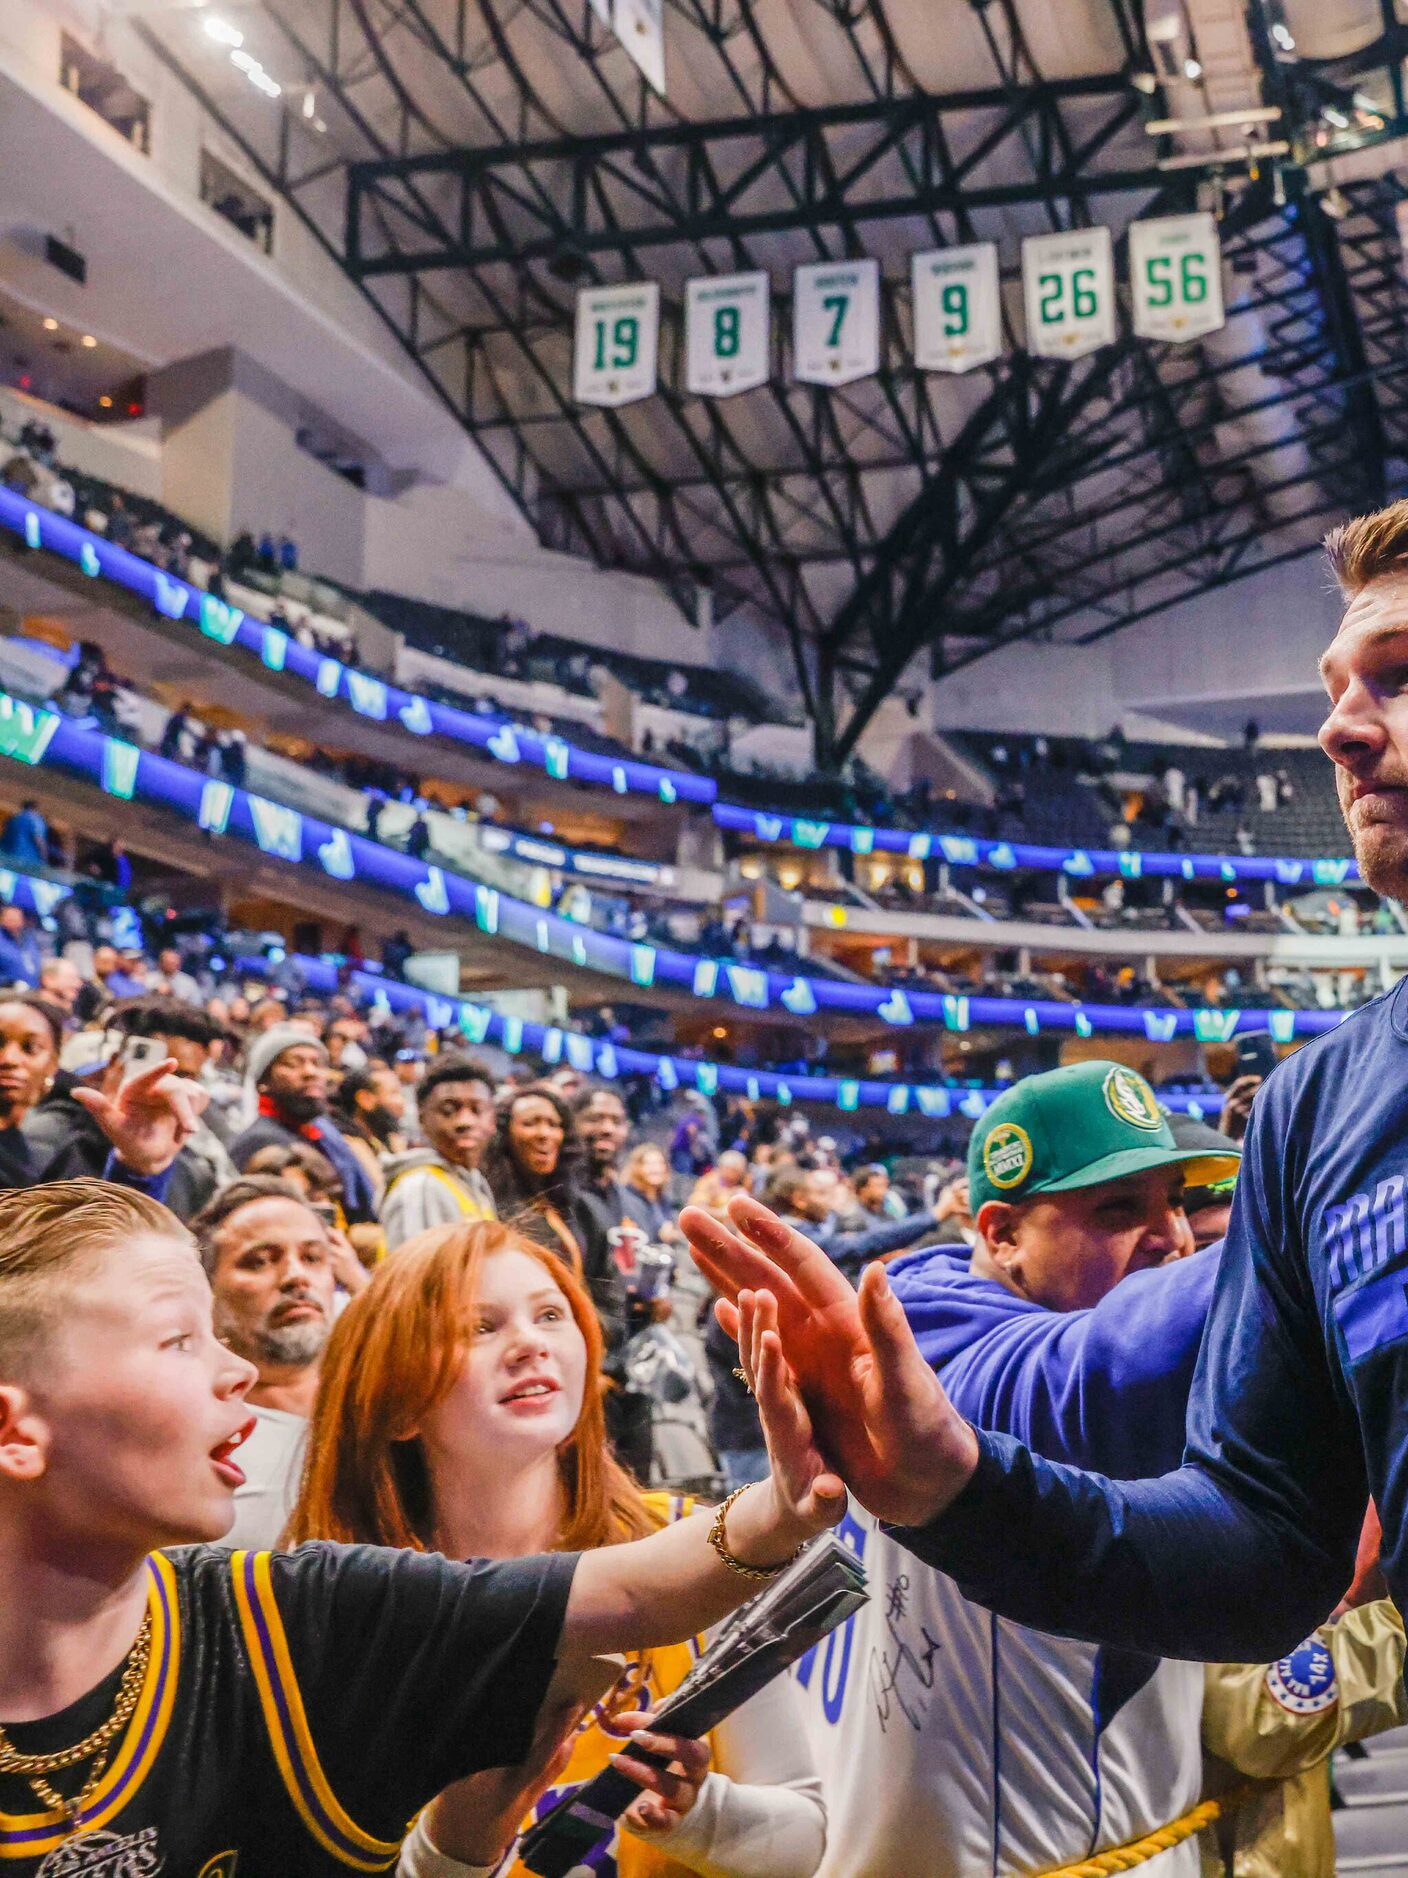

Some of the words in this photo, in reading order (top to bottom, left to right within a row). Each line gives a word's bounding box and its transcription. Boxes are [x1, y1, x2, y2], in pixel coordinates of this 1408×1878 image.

[1038, 269, 1098, 324] 26
[1146, 253, 1208, 308] 56
[714, 306, 741, 358] 8
[822, 295, 849, 347] 7
[942, 284, 968, 337] 9
[593, 316, 640, 370] 19
